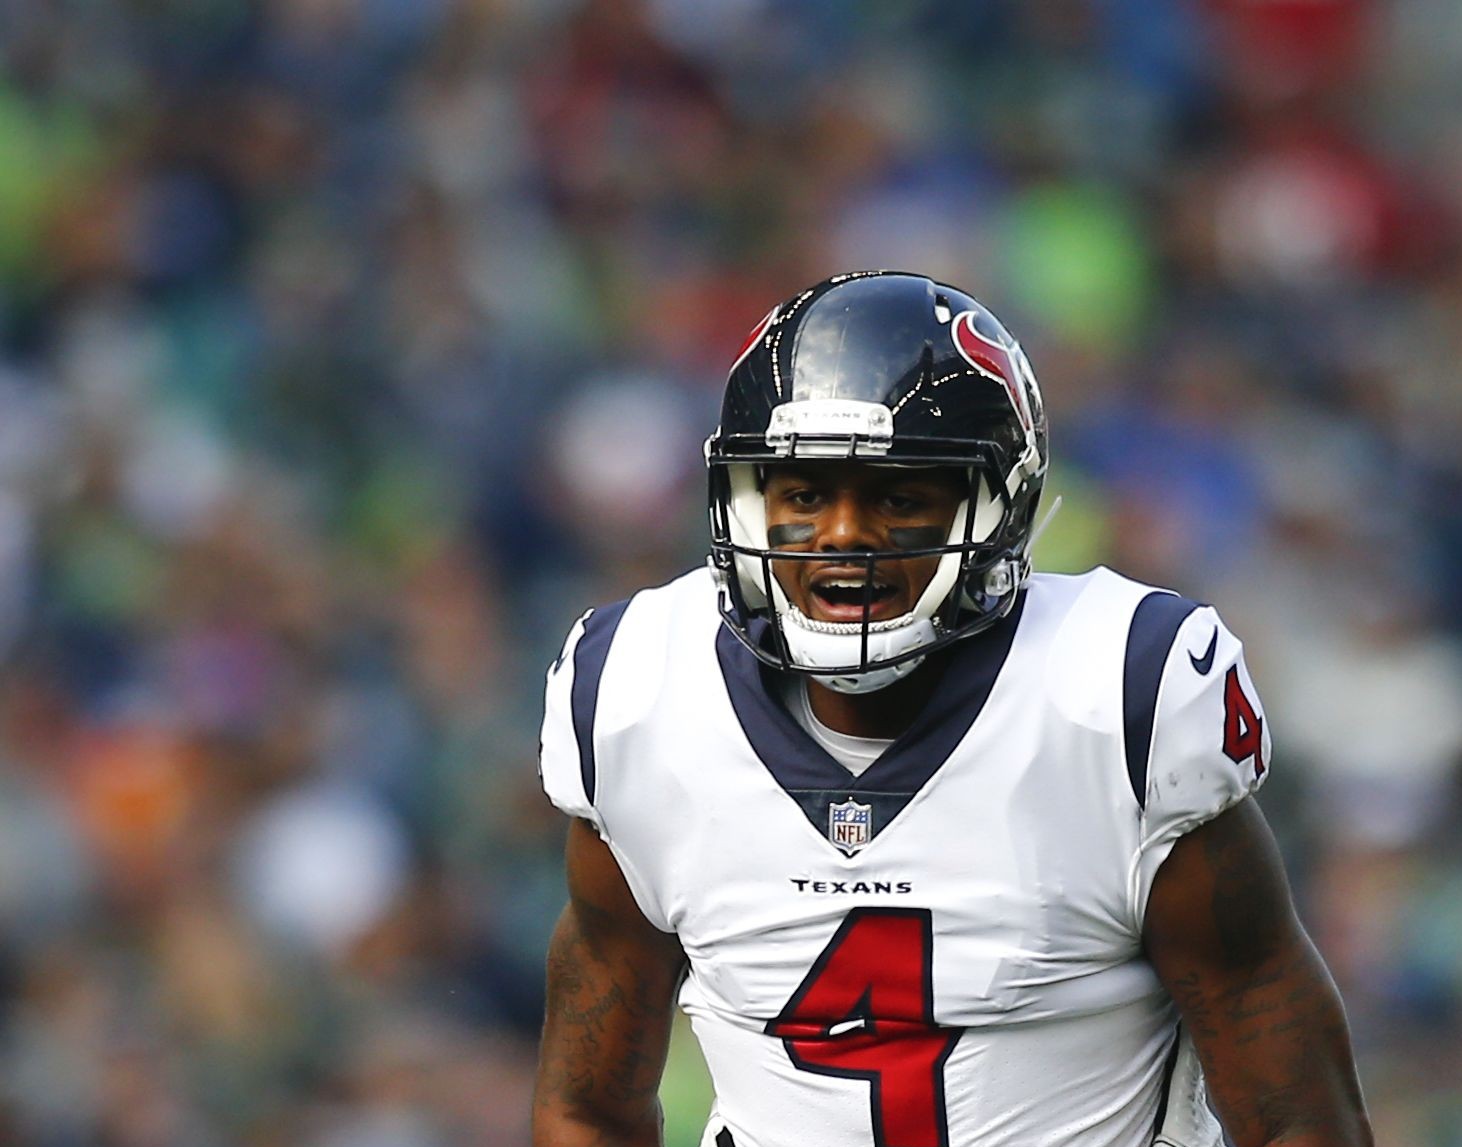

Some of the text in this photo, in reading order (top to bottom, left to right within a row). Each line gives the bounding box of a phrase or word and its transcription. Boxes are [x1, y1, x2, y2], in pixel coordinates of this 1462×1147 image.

[1222, 663, 1266, 780] 4
[836, 824, 865, 844] NFL
[790, 879, 912, 894] TEXANS
